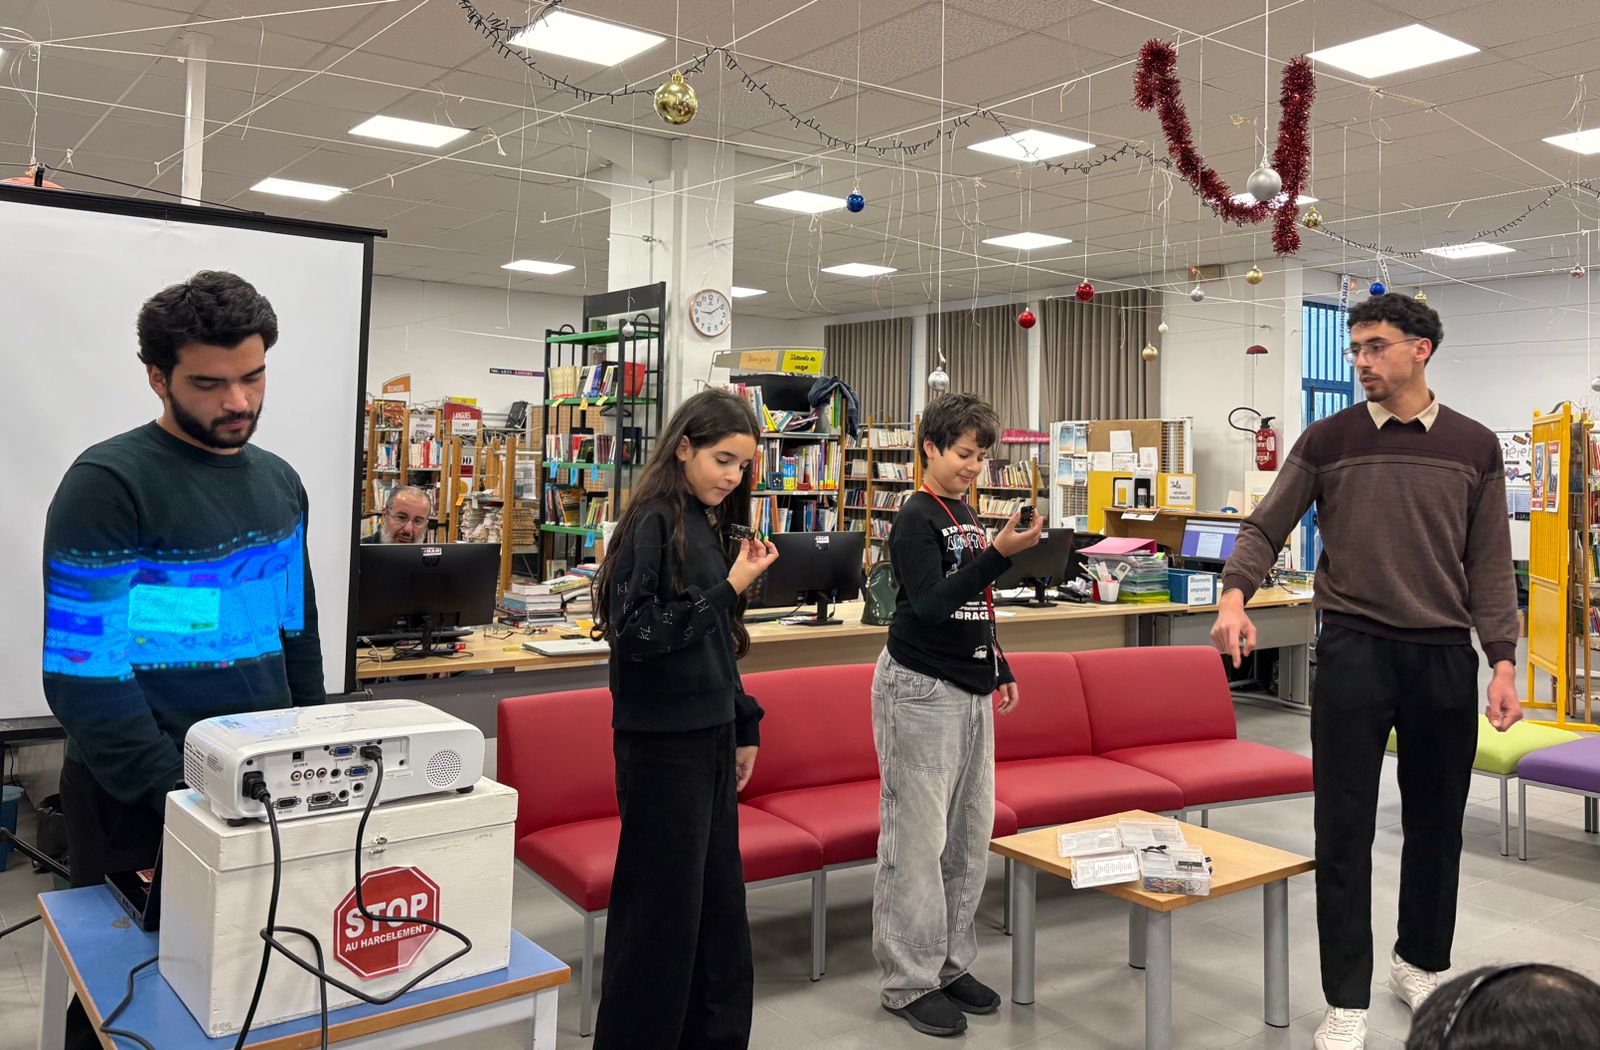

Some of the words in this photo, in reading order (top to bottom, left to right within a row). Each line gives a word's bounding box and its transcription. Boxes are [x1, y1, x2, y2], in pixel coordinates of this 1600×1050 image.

[452, 411, 471, 420] LANGUES
[345, 892, 428, 938] STOP
[345, 941, 359, 953] AU
[361, 924, 427, 949] HARCELEMENT
